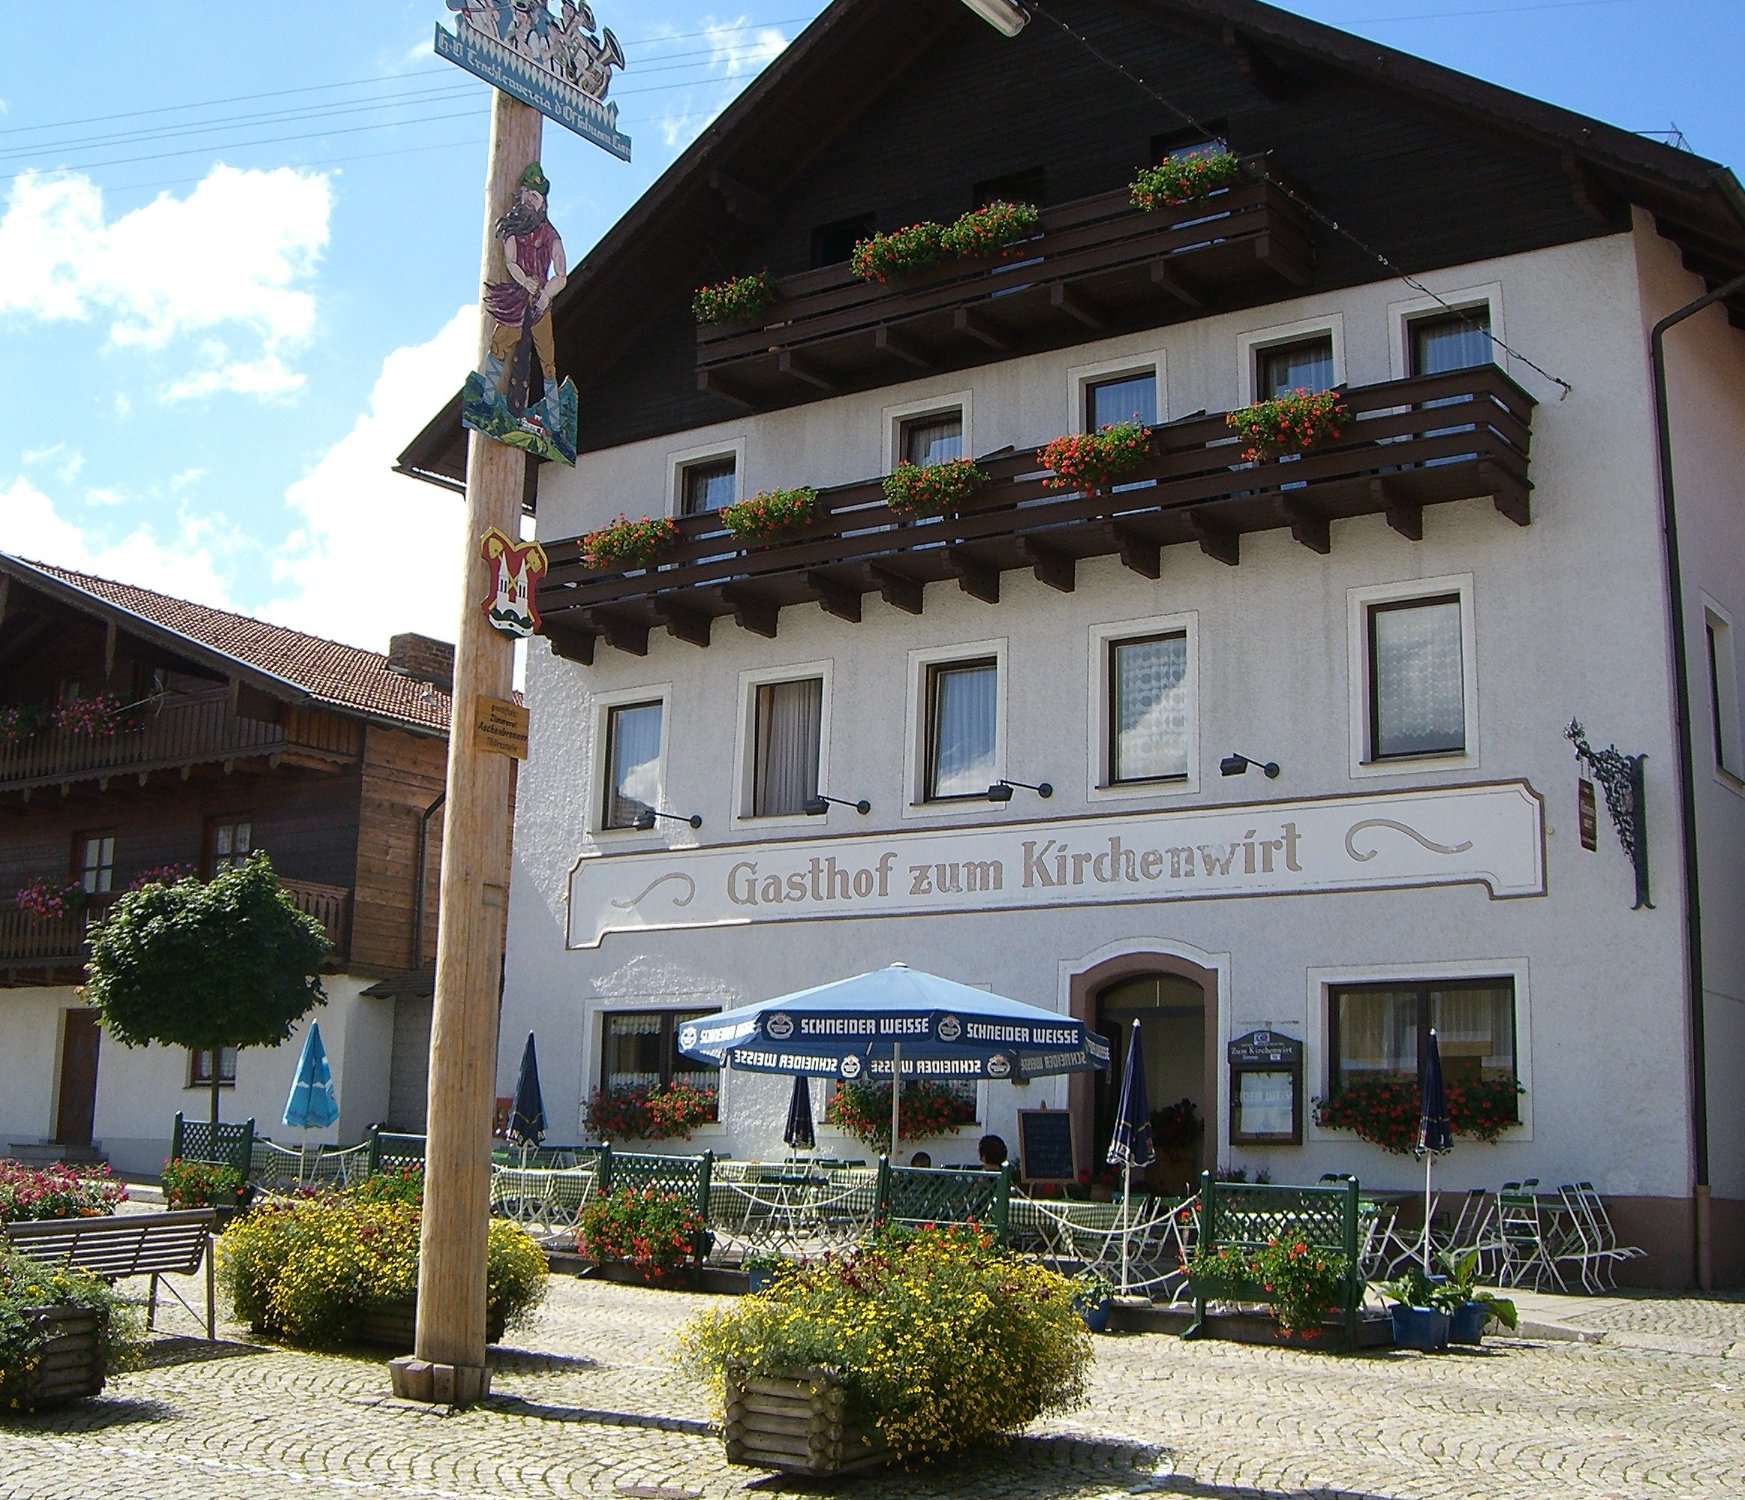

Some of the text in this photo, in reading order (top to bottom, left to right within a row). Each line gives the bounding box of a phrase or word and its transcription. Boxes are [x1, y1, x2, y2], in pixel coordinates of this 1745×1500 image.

[727, 821, 1303, 906] Gasthof zum Kirchenwirt
[801, 1018, 929, 1035] SCHNEIDER WEISSE
[966, 1022, 1079, 1044] SCHNEIDER WEISSE
